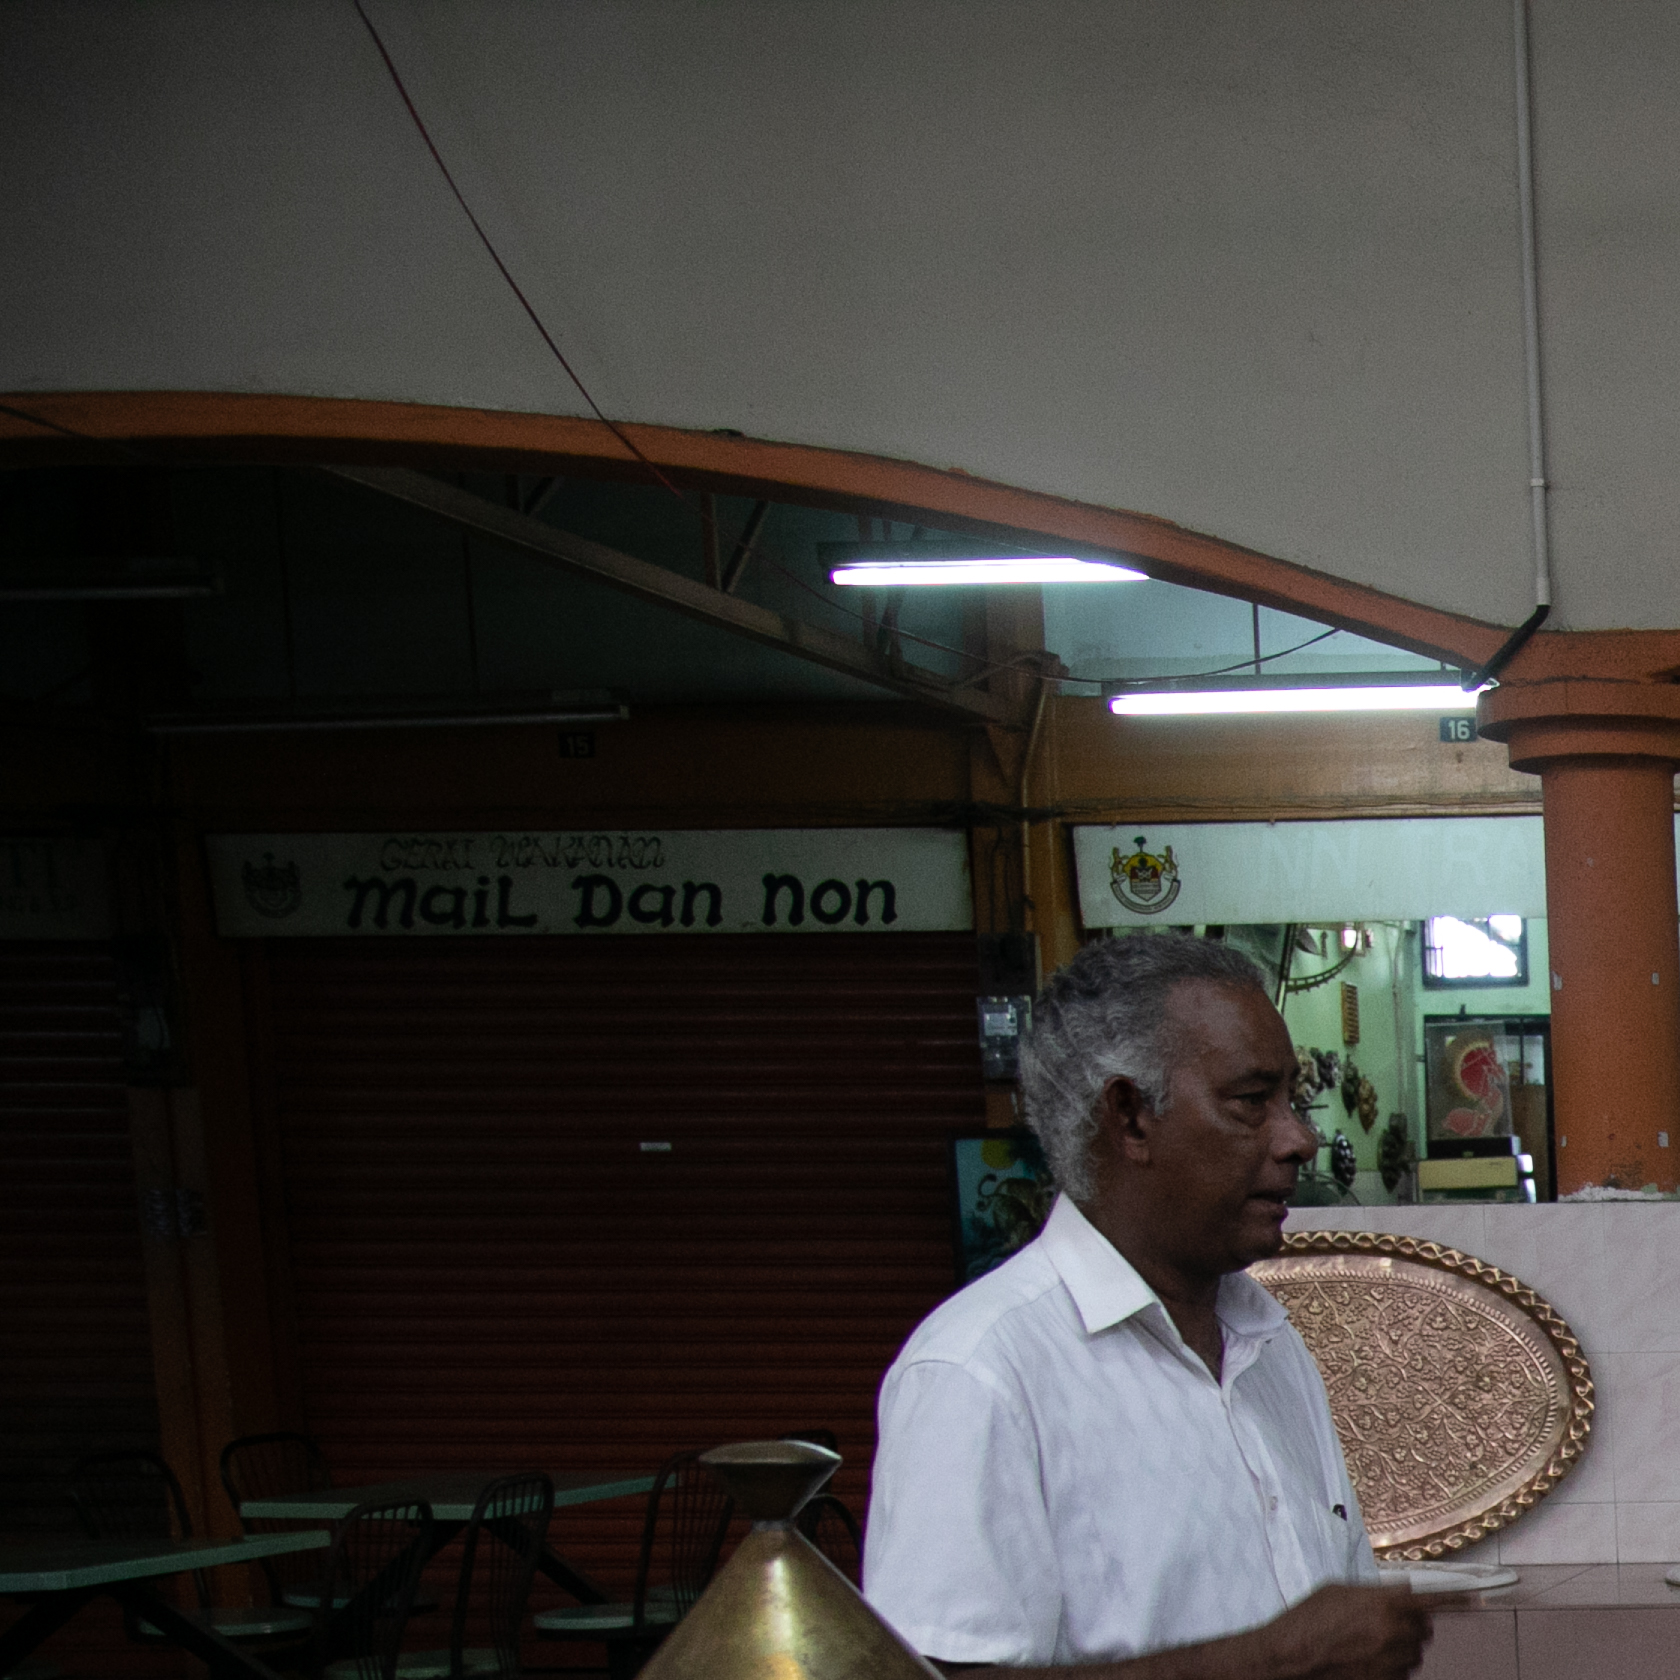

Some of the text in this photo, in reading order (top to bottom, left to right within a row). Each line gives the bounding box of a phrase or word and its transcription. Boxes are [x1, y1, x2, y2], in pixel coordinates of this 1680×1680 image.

[1448, 719, 1471, 740] 16
[566, 734, 590, 757] 15
[573, 873, 725, 928] Dan
